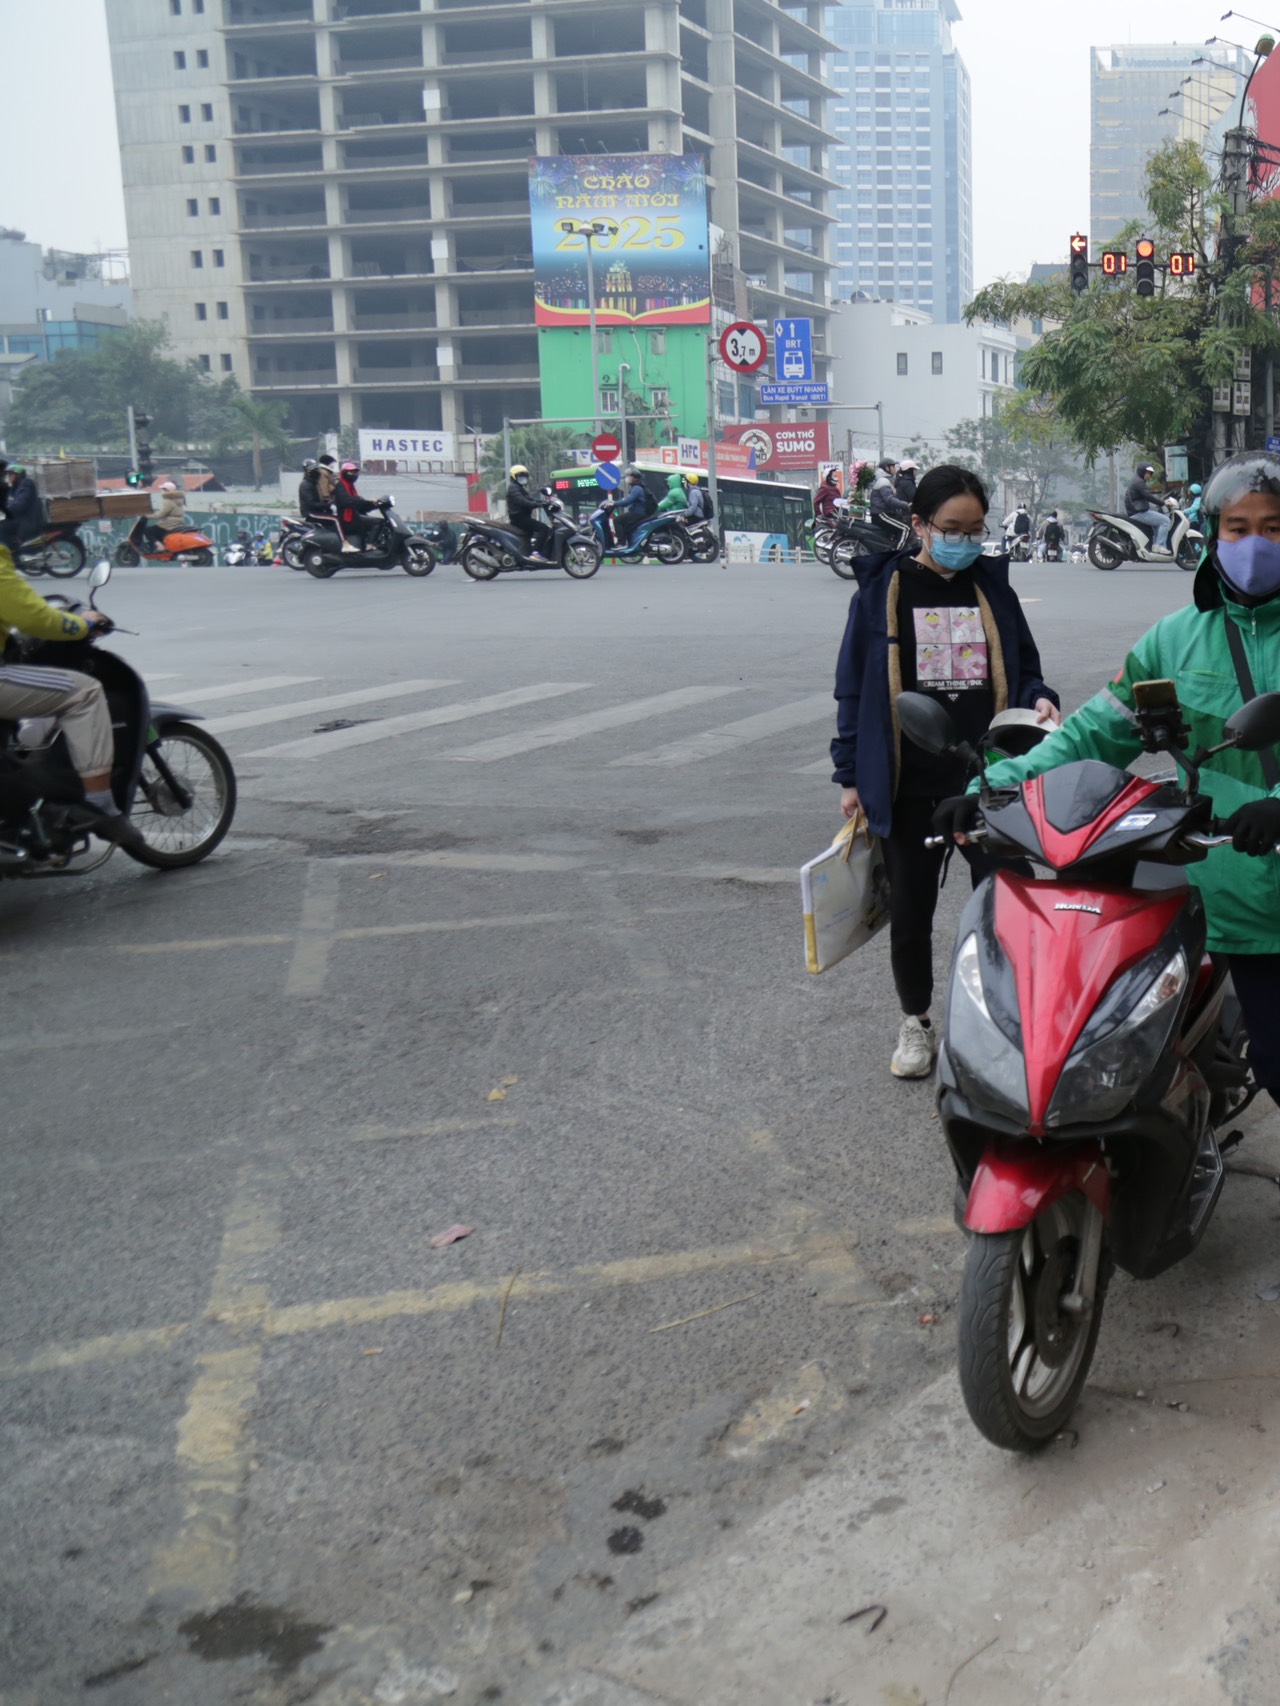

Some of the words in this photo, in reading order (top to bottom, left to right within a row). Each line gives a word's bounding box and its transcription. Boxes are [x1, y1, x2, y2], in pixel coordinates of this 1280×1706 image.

[553, 215, 686, 252] 2025
[1103, 253, 1126, 273] 01
[1171, 255, 1193, 274] 01
[785, 339, 801, 349] BRT
[777, 385, 786, 393] XE
[775, 431, 796, 440] CƠM
[372, 438, 443, 453] HASTEC
[681, 443, 699, 460] HFC
[776, 440, 816, 453] SUMO
[946, 679, 967, 688] THINK
[1055, 903, 1102, 915] HONDA
